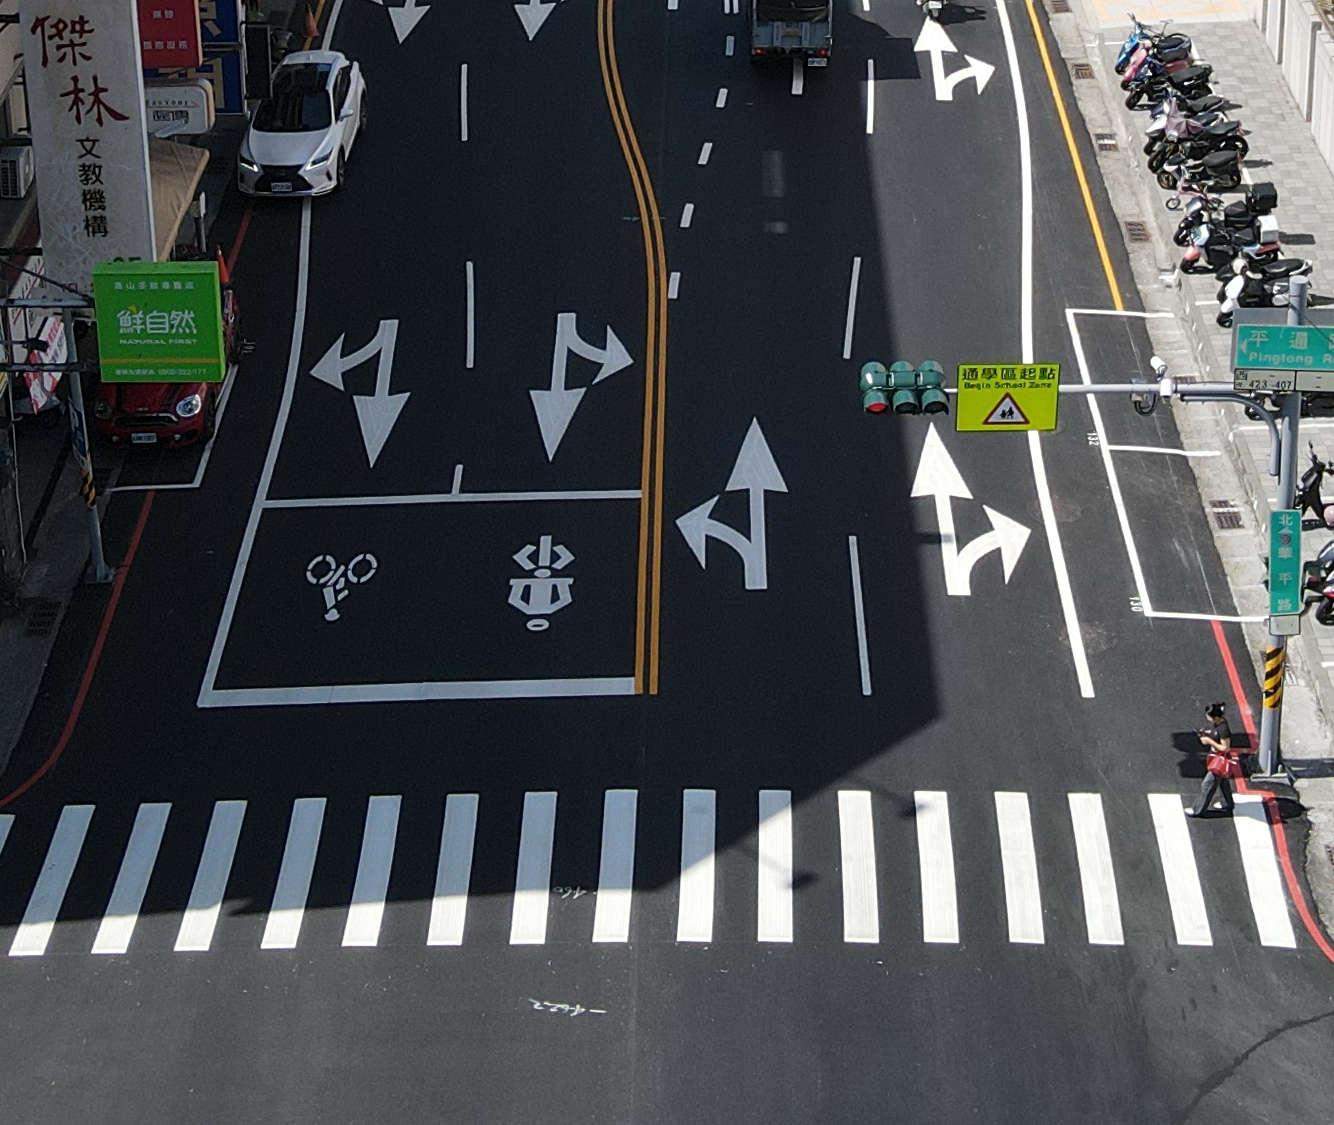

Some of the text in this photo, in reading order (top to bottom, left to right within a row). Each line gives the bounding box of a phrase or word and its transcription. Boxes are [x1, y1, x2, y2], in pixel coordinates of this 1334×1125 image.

[31, 14, 130, 128] 傑林
[75, 136, 109, 238] 文教機構
[116, 308, 198, 335] 鮮自然
[1248, 352, 1314, 366] Pingtong
[962, 367, 1057, 381] 通學區起點
[994, 381, 1026, 389] School
[1278, 513, 1294, 526] 北
[1277, 545, 1294, 612] 華平路
